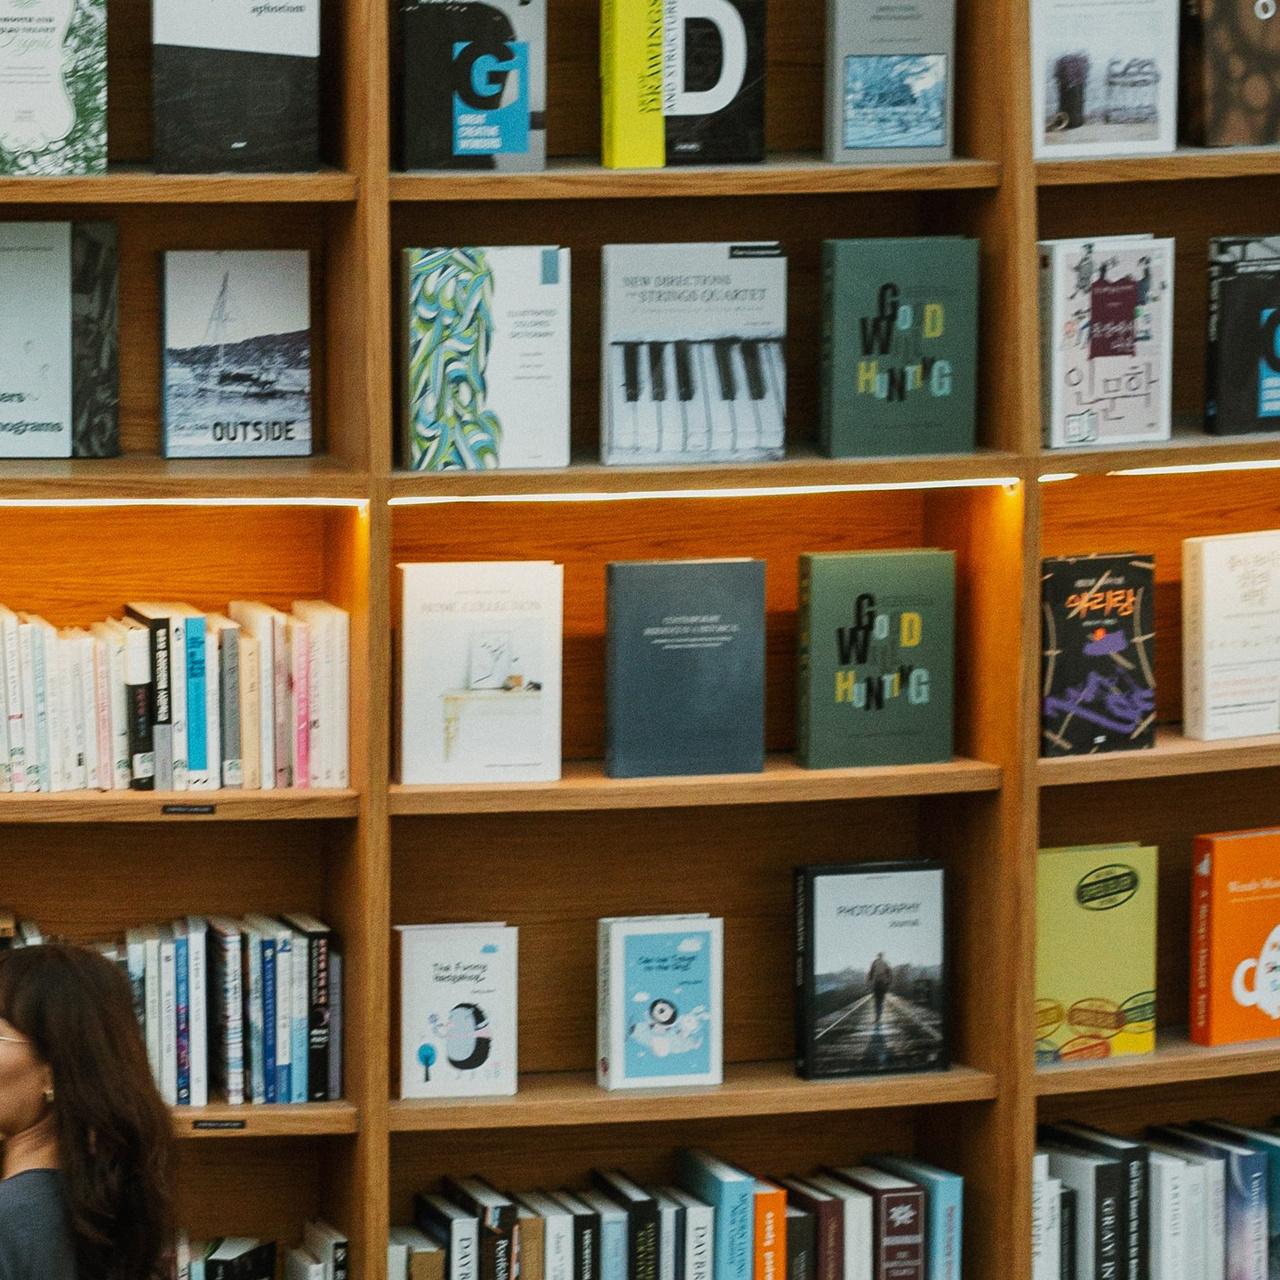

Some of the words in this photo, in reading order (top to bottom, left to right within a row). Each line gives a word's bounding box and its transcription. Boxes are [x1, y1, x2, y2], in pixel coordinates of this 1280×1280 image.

[453, 39, 518, 111] G
[664, 93, 677, 113] AND
[212, 420, 296, 442] OUTSIDE
[836, 902, 921, 916] PHOTOGRAPHY
[763, 1211, 775, 1247] Space
[1101, 1197, 1116, 1257] GRAY
